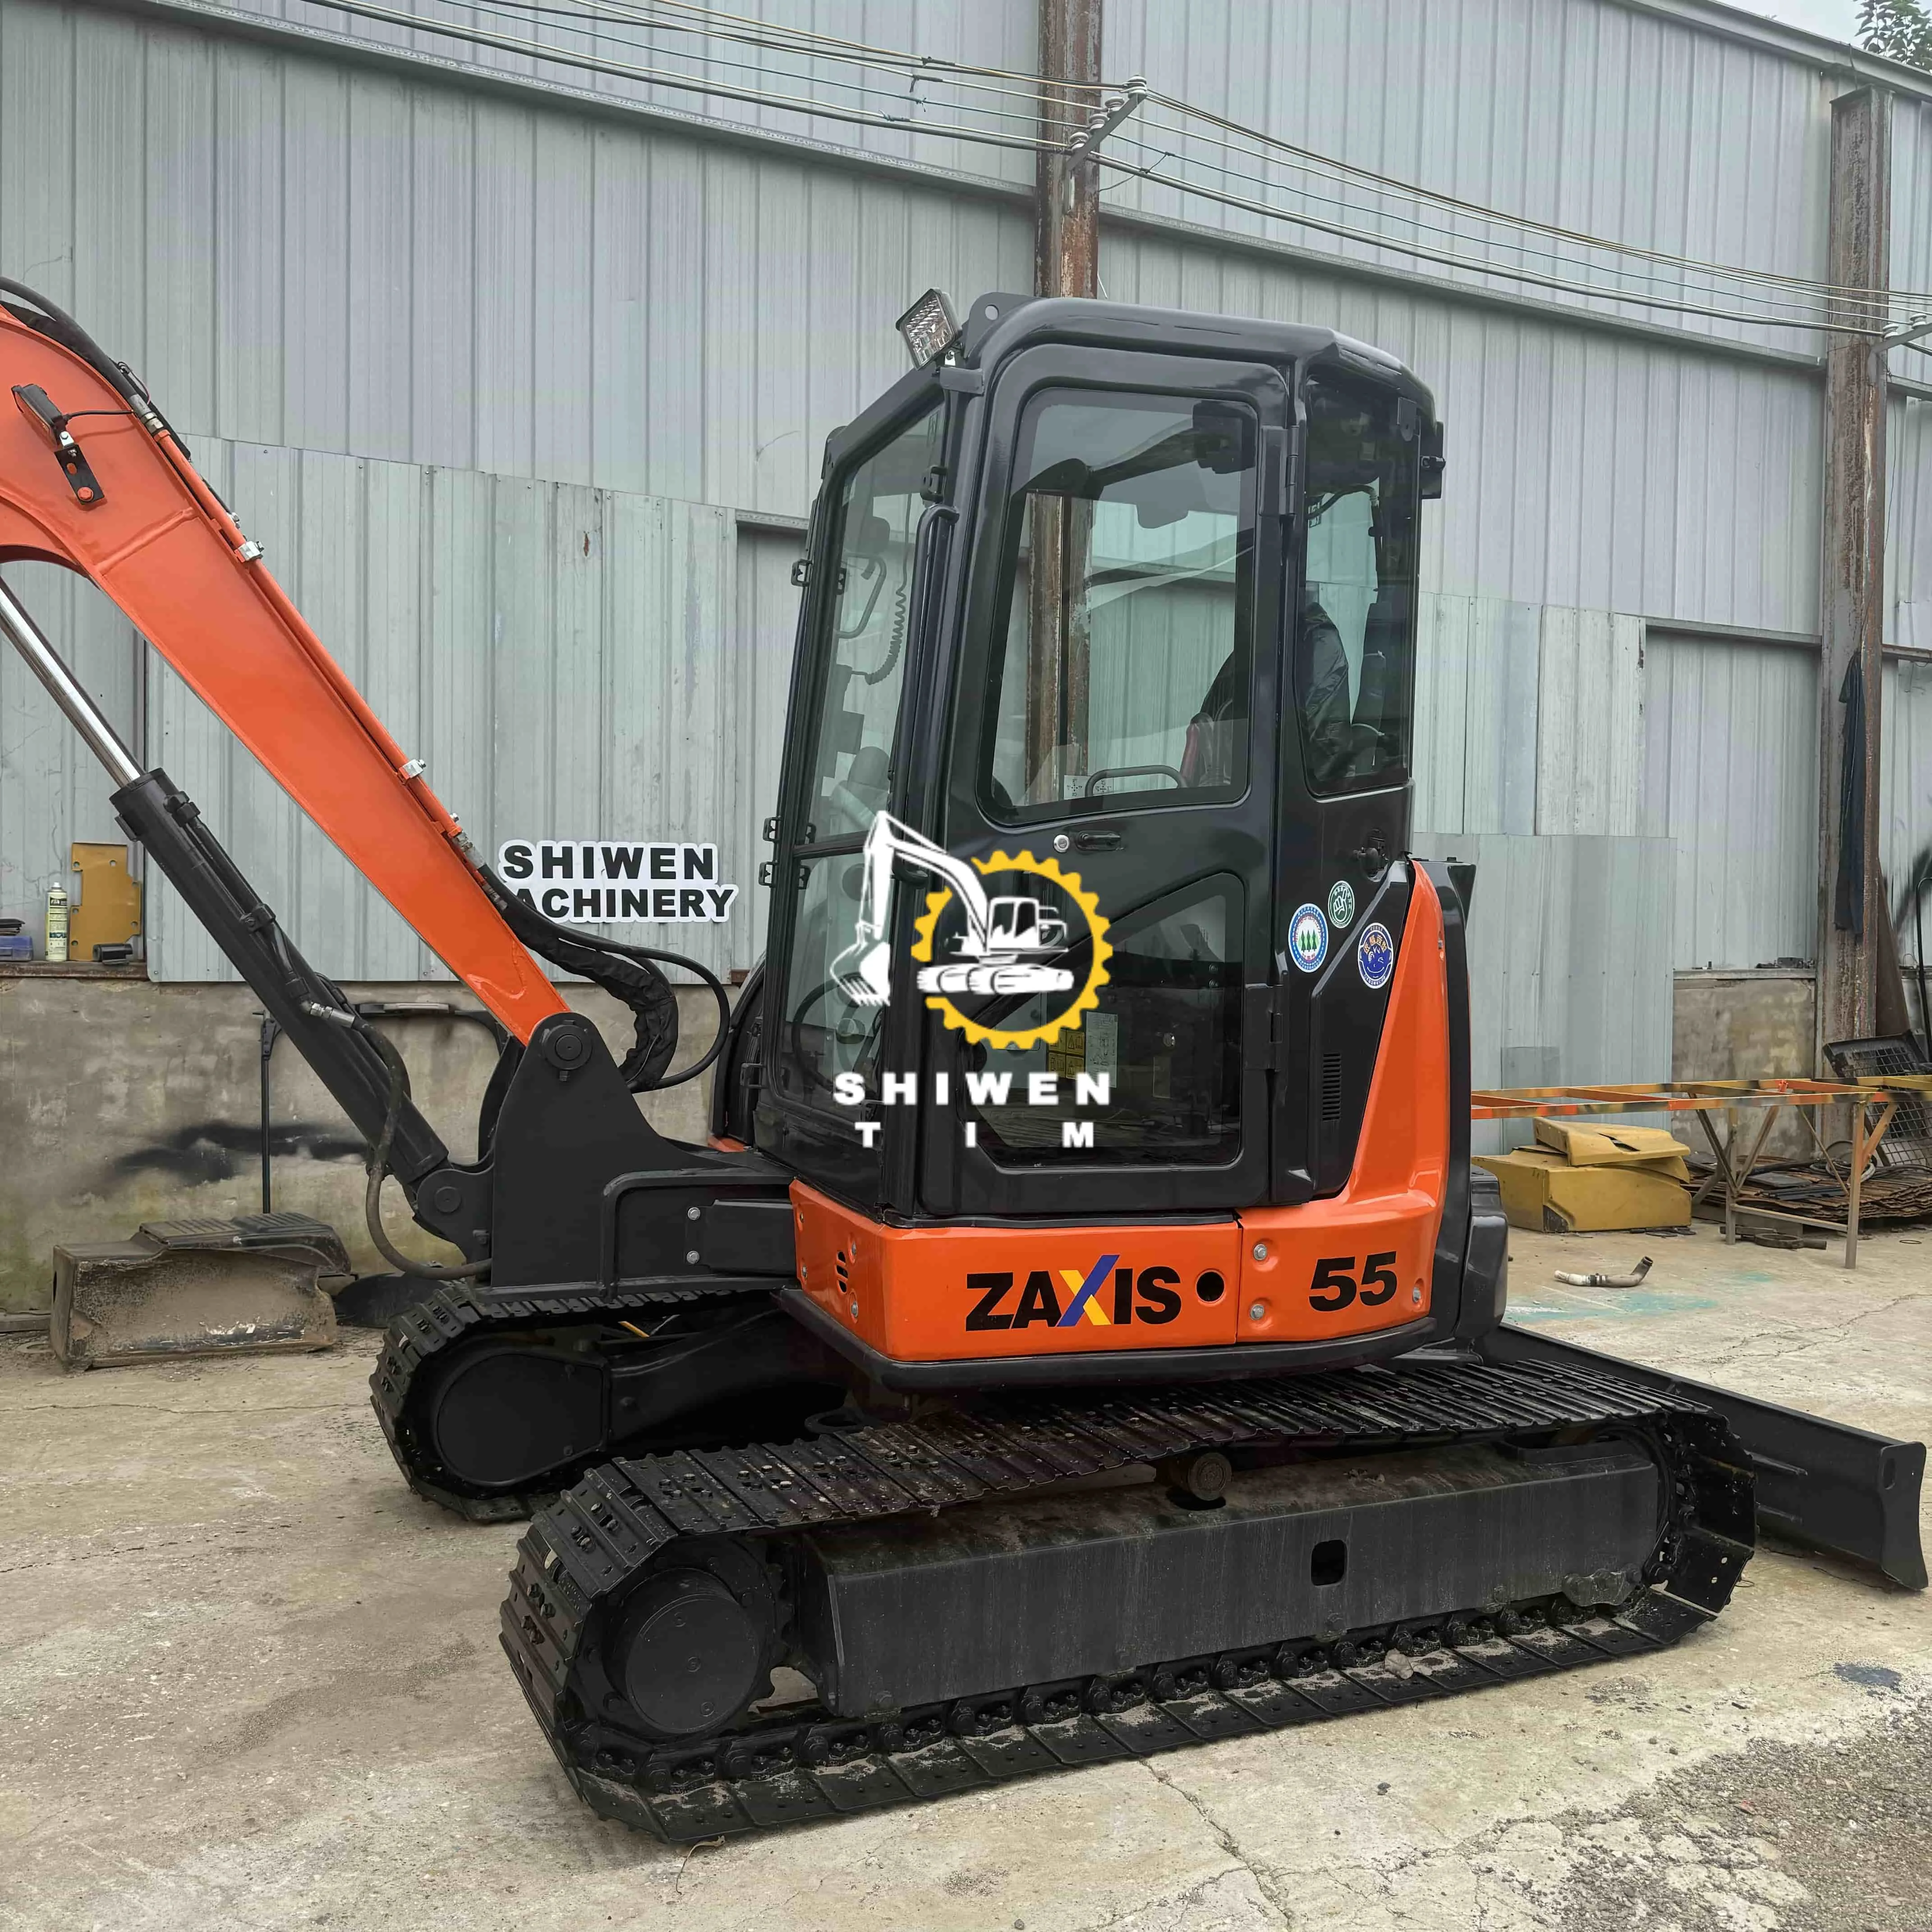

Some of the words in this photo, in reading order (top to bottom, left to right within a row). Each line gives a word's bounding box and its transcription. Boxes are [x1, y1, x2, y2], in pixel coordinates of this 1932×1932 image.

[503, 845, 713, 879] SHIWEN
[516, 888, 734, 918] ACHINERY
[965, 1254, 1182, 1332] ZAXIS
[1308, 1251, 1398, 1312] 55
